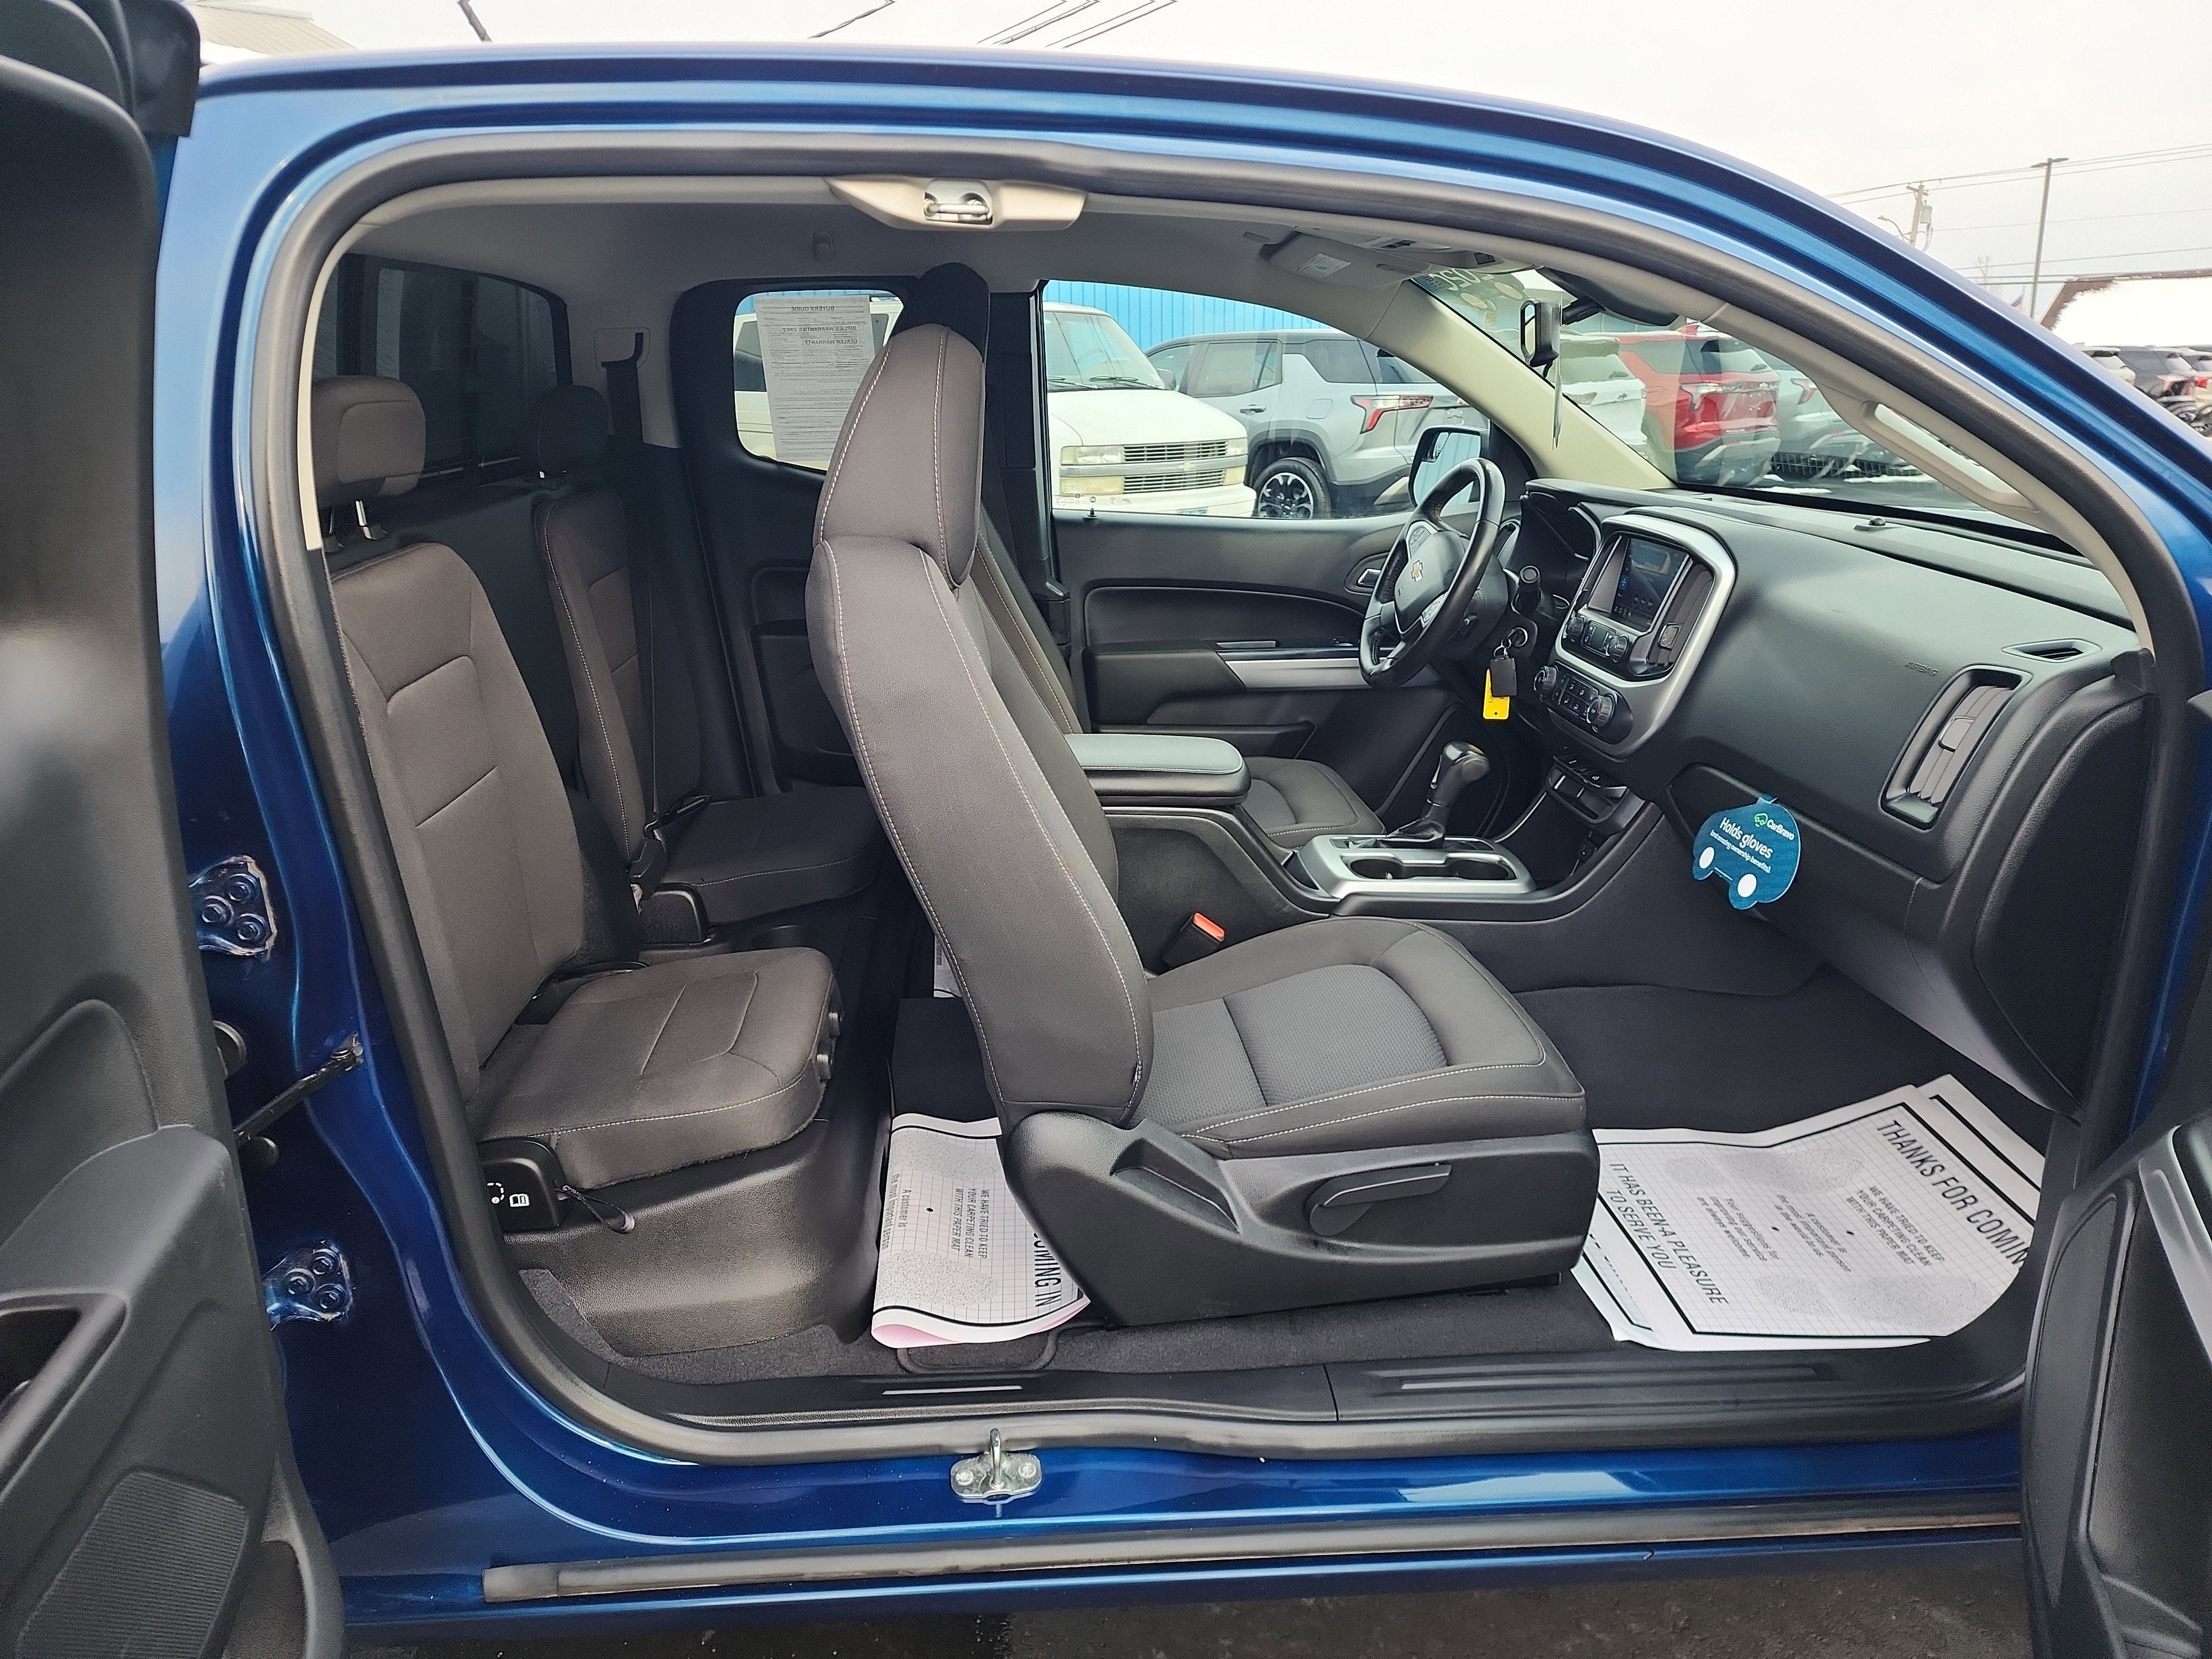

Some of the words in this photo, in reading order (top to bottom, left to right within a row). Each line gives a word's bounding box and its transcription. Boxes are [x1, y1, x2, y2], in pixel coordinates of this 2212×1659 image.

[1719, 817, 1743, 840] Holds
[1739, 834, 1773, 859] gloves
[1766, 819, 1795, 841] CarBravo
[1610, 1164, 1630, 1173] IT
[1877, 1120, 1945, 1177] THANKS
[1932, 1177, 1979, 1211] FOR
[891, 1173, 900, 1183] the
[1618, 1176, 1646, 1196] HAS
[889, 1184, 897, 1199] most
[954, 1188, 964, 1203] WITH
[967, 1188, 977, 1203] YOUR
[980, 1190, 989, 1198] WE
[884, 1199, 897, 1228] important
[899, 1195, 910, 1220] customer
[953, 1203, 963, 1217] THIS
[980, 1199, 989, 1214] HAVE
[1636, 1199, 1670, 1226] BEEN
[952, 1217, 962, 1237] PAPER
[966, 1204, 976, 1237] CARPETING
[979, 1215, 989, 1233] TRIED
[1606, 1190, 1627, 1203] TO
[1618, 1207, 1656, 1241] SERVE
[1647, 1244, 1677, 1269] YOU
[1870, 1185, 1884, 1198] WE
[1879, 1197, 1900, 1215] HAVE
[1896, 1214, 1918, 1234] TRIED
[1914, 1234, 1928, 1244] TO
[1923, 1244, 1945, 1261] KEEP
[881, 1228, 891, 1250] person
[951, 1237, 961, 1251] MAT
[1872, 1208, 1911, 1244] CARPETING
[1906, 1244, 1932, 1266] CLEAN
[1875, 1228, 1901, 1250] PAPER
[1896, 1250, 1915, 1265] MAT
[964, 1238, 974, 1258] CLEAN
[978, 1244, 988, 1259] KEEP
[1667, 1240, 1729, 1304] PLEASURE
[1035, 1290, 1062, 1307] IN
